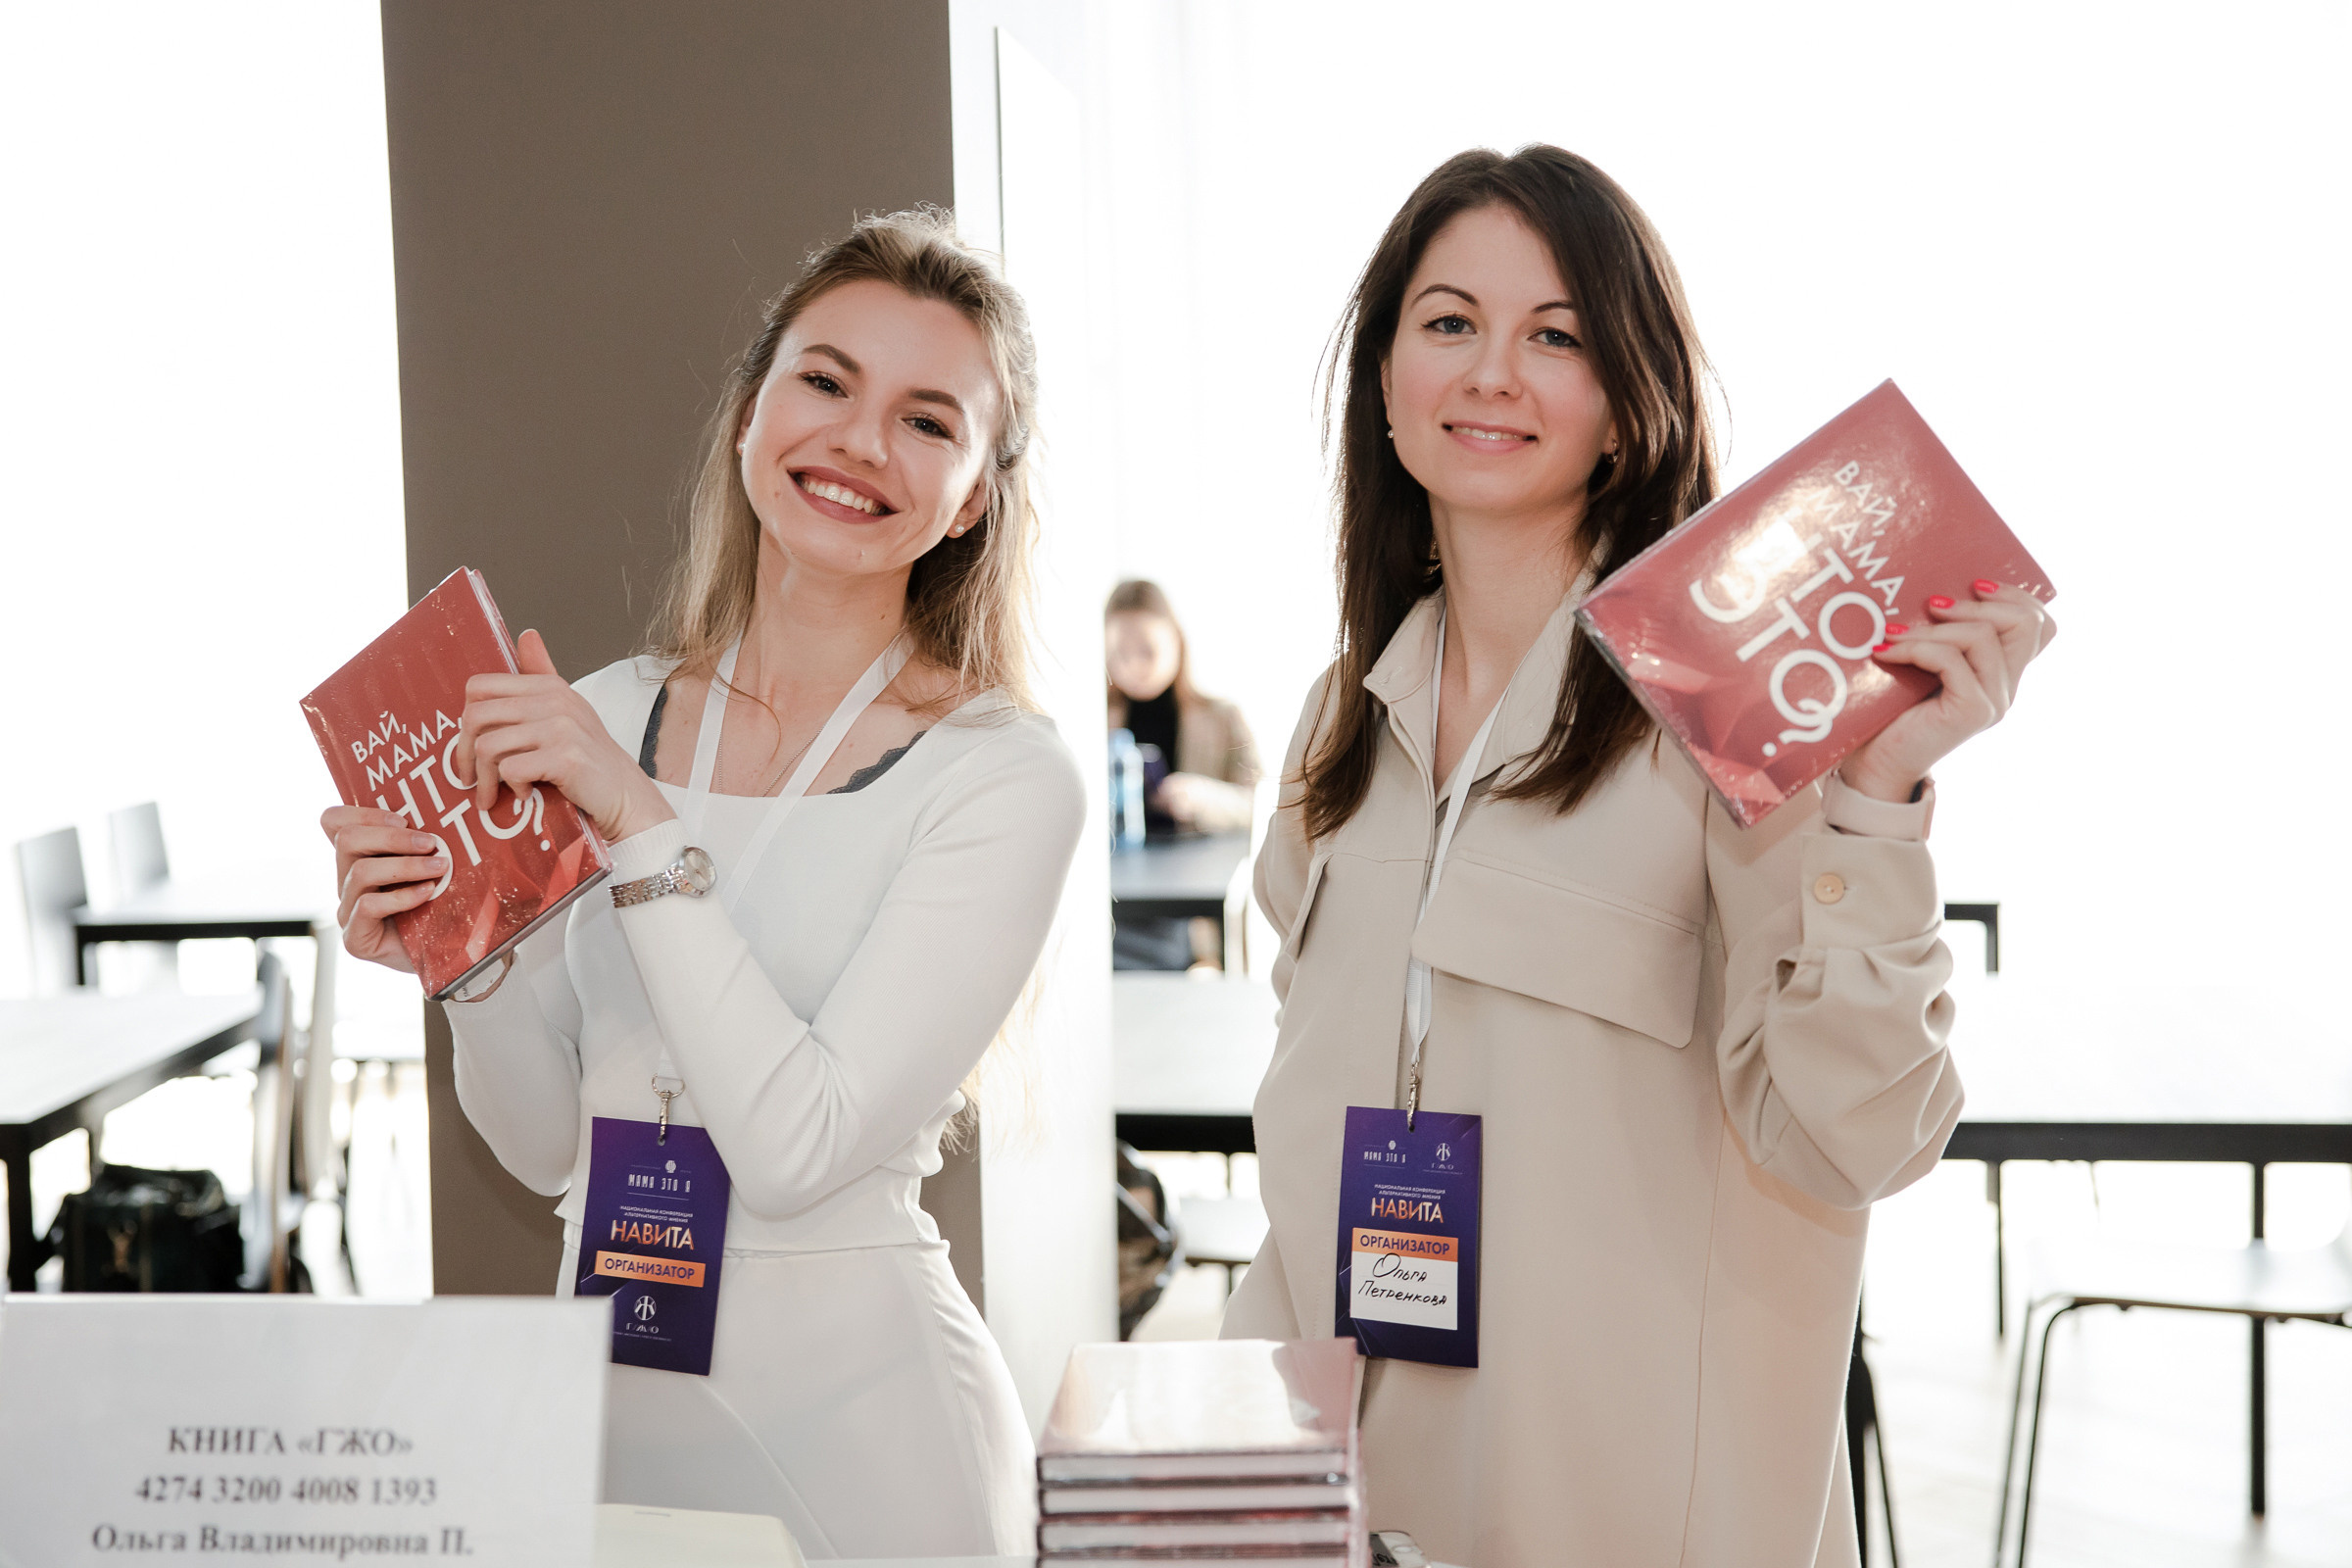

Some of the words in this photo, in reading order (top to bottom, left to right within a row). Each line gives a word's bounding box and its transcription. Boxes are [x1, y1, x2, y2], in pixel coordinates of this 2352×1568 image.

[1834, 460, 1897, 537] ВАЙ,
[1804, 485, 1905, 615] МАМА,
[351, 710, 407, 764] ВАЙ,
[366, 710, 462, 792] МАМА,
[627, 1174, 655, 1189] МАМА
[661, 1177, 678, 1192] ЭТО
[1371, 1197, 1445, 1224] НАВИТА
[611, 1219, 695, 1250] НАВИТА
[1360, 1234, 1450, 1255] ОРГАНИЗАТОР
[605, 1257, 695, 1279] ОРГАНИЗАТОР
[1372, 1252, 1428, 1282] Ольга
[1358, 1280, 1447, 1306] Петренкова
[168, 1427, 286, 1456] КНИГА
[297, 1427, 414, 1456] «ГЖО»
[135, 1476, 204, 1504] 4274
[212, 1476, 282, 1504] 3200
[290, 1477, 360, 1505] 4008
[371, 1477, 437, 1506] 1393
[91, 1524, 188, 1553] Ольга
[199, 1525, 428, 1561] Владимировна
[440, 1528, 474, 1556] П.
